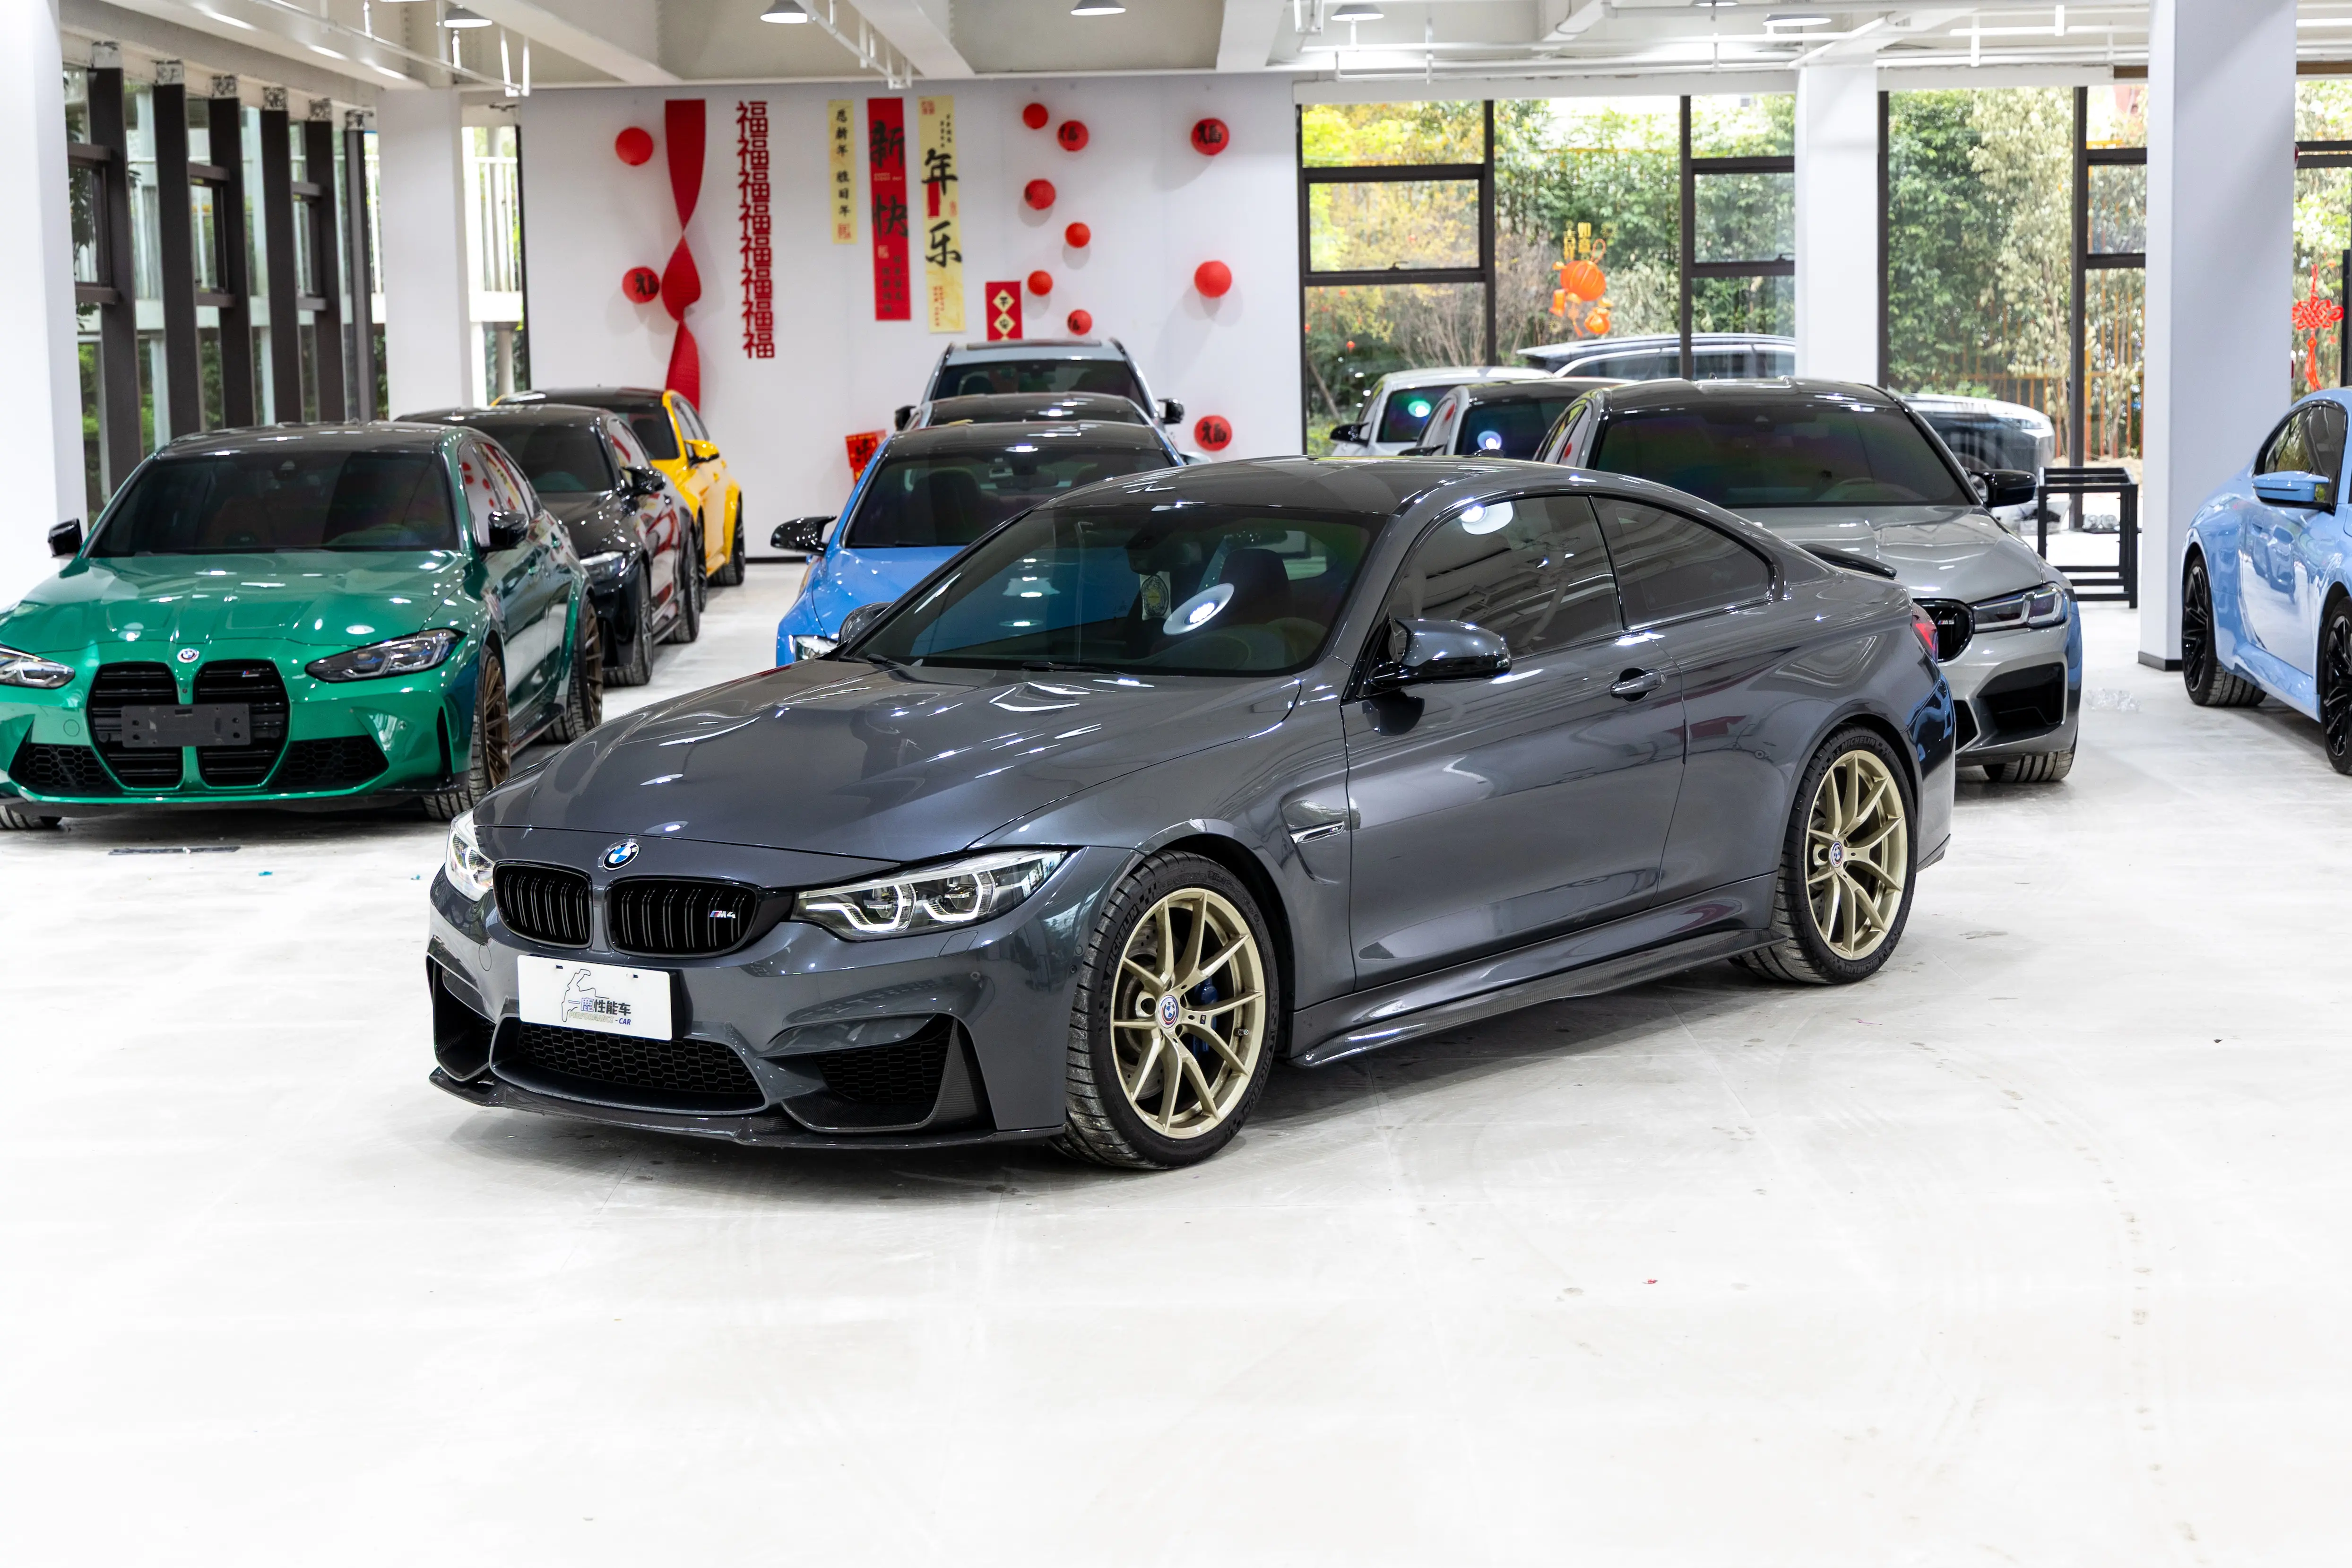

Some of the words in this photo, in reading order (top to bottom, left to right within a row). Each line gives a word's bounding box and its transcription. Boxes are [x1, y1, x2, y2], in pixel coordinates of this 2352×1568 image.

[1842, 736, 1876, 749] MICHELIN
[714, 910, 736, 918] M4
[1106, 903, 1140, 975] MICHELIN
